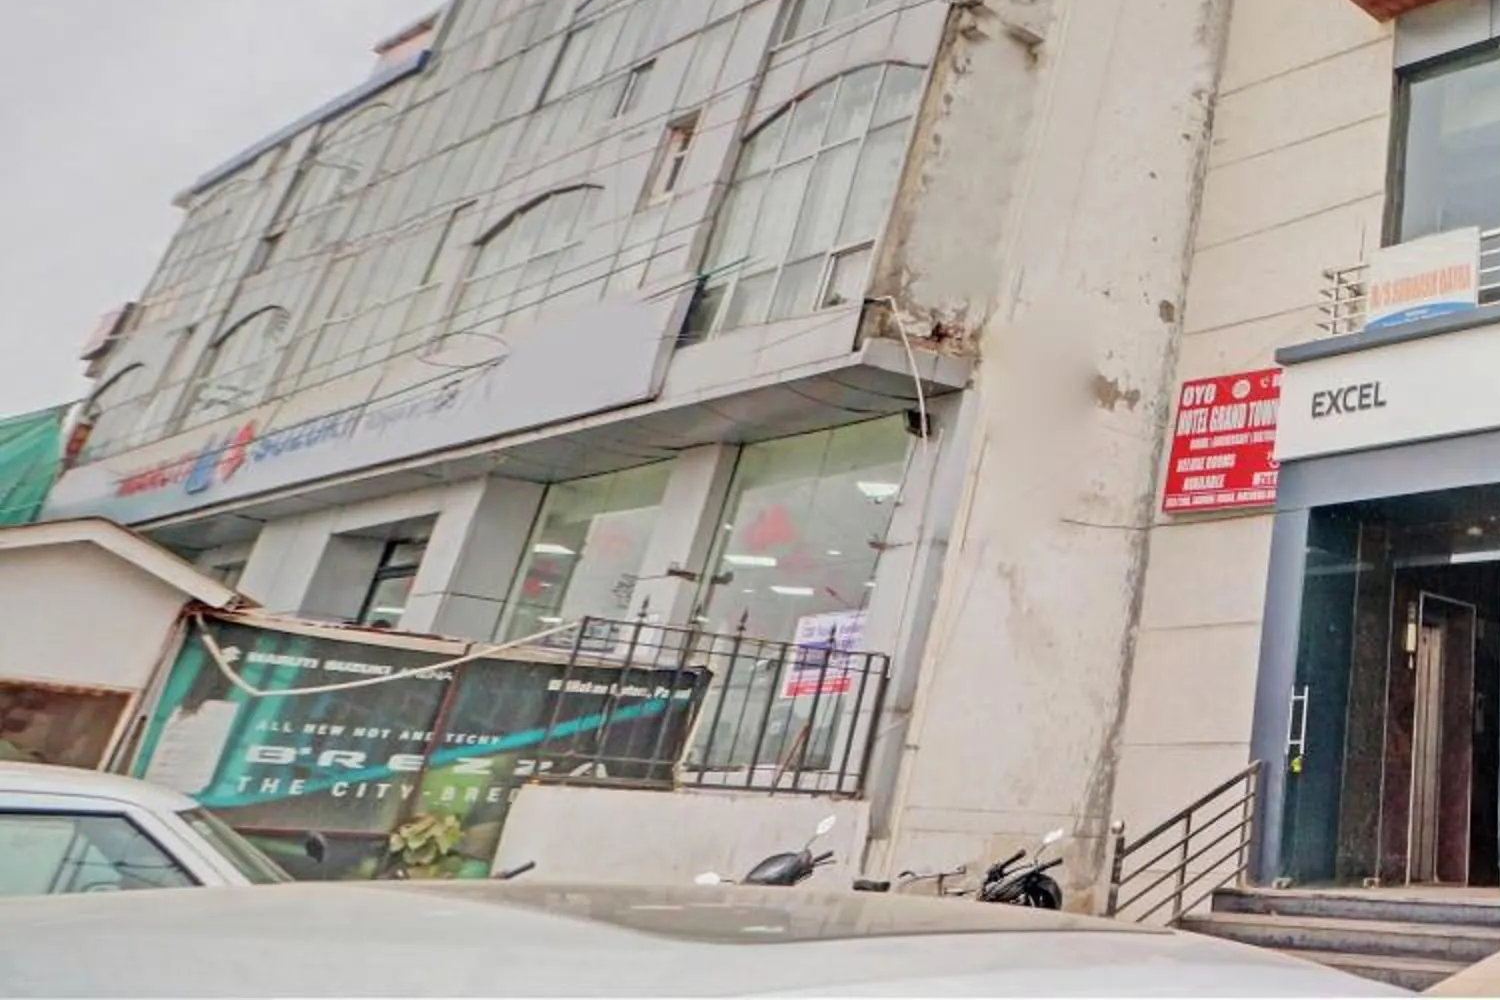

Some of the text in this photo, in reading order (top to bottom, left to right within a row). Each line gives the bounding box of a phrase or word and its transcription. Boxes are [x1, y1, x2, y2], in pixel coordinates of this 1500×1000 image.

[1181, 383, 1217, 408] OYO
[1310, 381, 1388, 418] EXCEL
[323, 658, 393, 677] SUZUKI
[256, 720, 293, 733] ALL
[303, 723, 347, 737] NEW
[353, 726, 392, 739] HOT
[236, 775, 305, 796] THE
